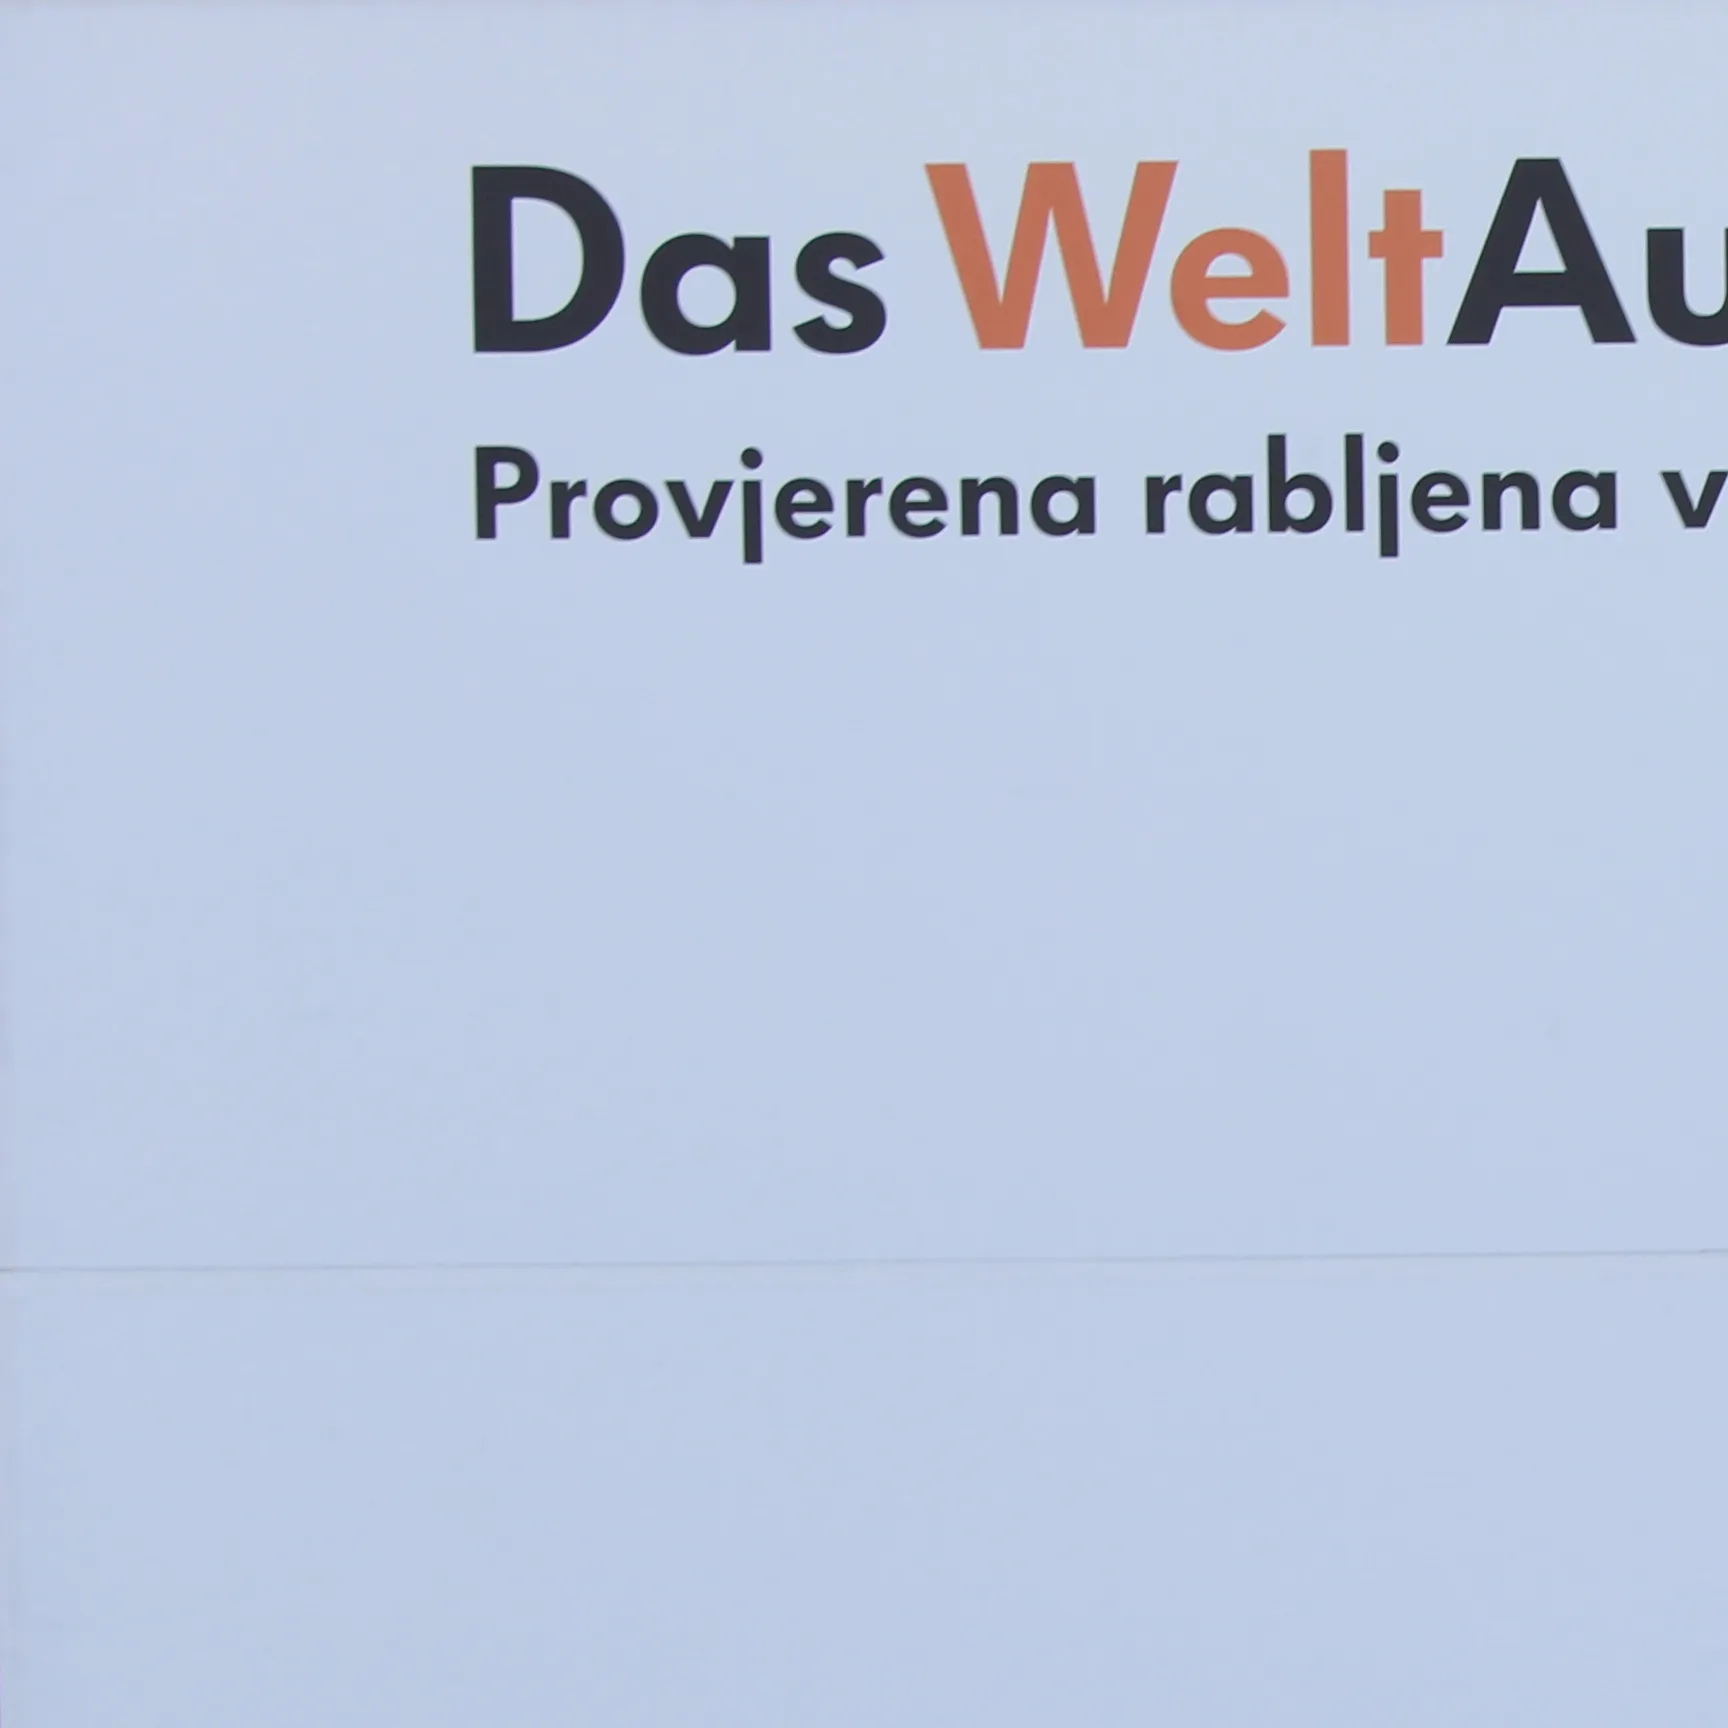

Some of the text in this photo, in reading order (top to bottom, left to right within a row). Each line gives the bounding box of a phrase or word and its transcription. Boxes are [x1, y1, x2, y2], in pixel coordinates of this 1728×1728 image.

[471, 164, 887, 356] Das
[474, 434, 1097, 566] Provjerena
[1144, 432, 1618, 559] rabljena
